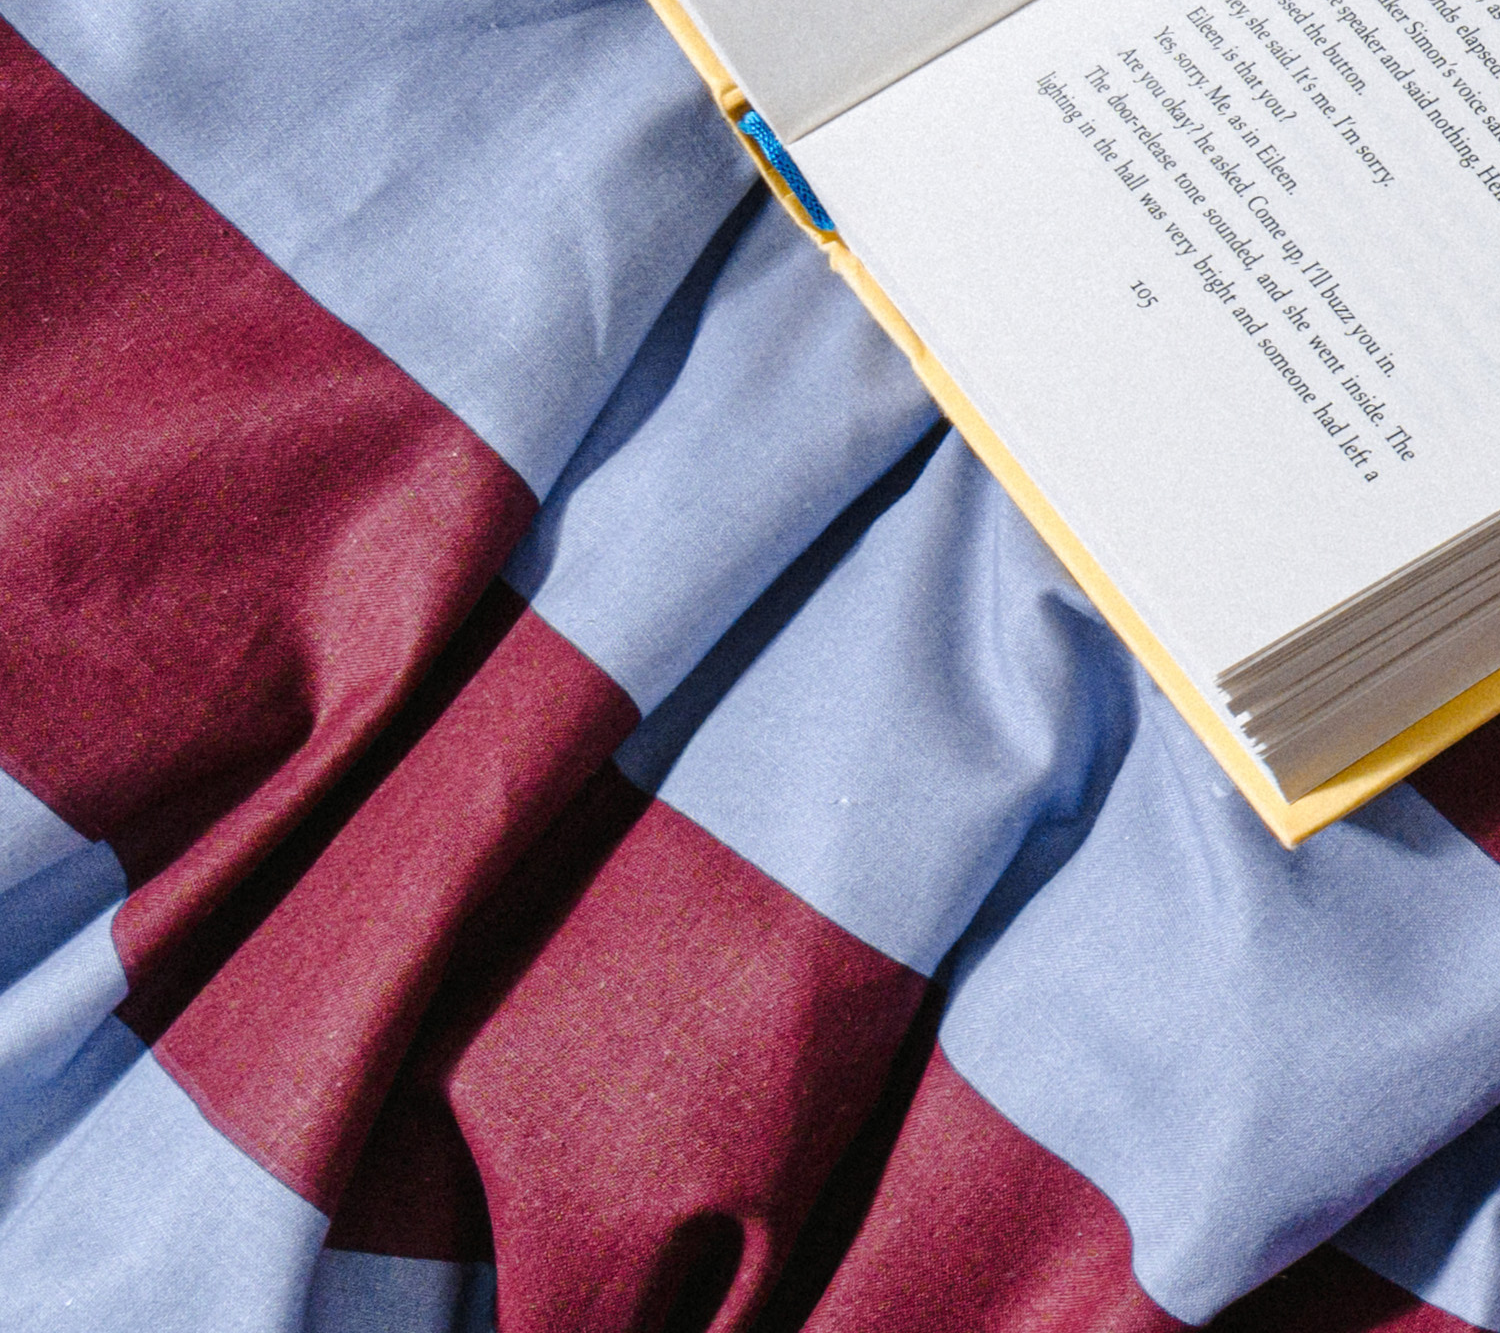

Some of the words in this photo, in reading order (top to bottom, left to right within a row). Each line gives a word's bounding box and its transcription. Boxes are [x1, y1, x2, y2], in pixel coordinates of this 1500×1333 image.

[1152, 24, 1178, 55] Yes,
[1172, 51, 1211, 91] sorry.
[1203, 83, 1232, 117] Me,
[1226, 114, 1249, 132] as
[1240, 127, 1261, 149] in
[1254, 143, 1298, 197] Eileen.
[1185, 4, 1226, 52] Eileen,
[1220, 47, 1240, 63] is
[1232, 59, 1264, 91] that
[1250, 87, 1299, 124] you?
[1301, 21, 1329, 48] the
[1320, 40, 1367, 97] button.
[1083, 63, 1112, 95] The
[1105, 92, 1178, 172] door-release
[1172, 171, 1207, 207] tone
[1201, 207, 1266, 273] sounded,
[1255, 272, 1295, 304] and
[1281, 304, 1312, 333] she
[1307, 333, 1346, 376] went
[1339, 373, 1387, 429] inside.
[1384, 423, 1416, 463] The
[1129, 278, 1160, 309] 105
